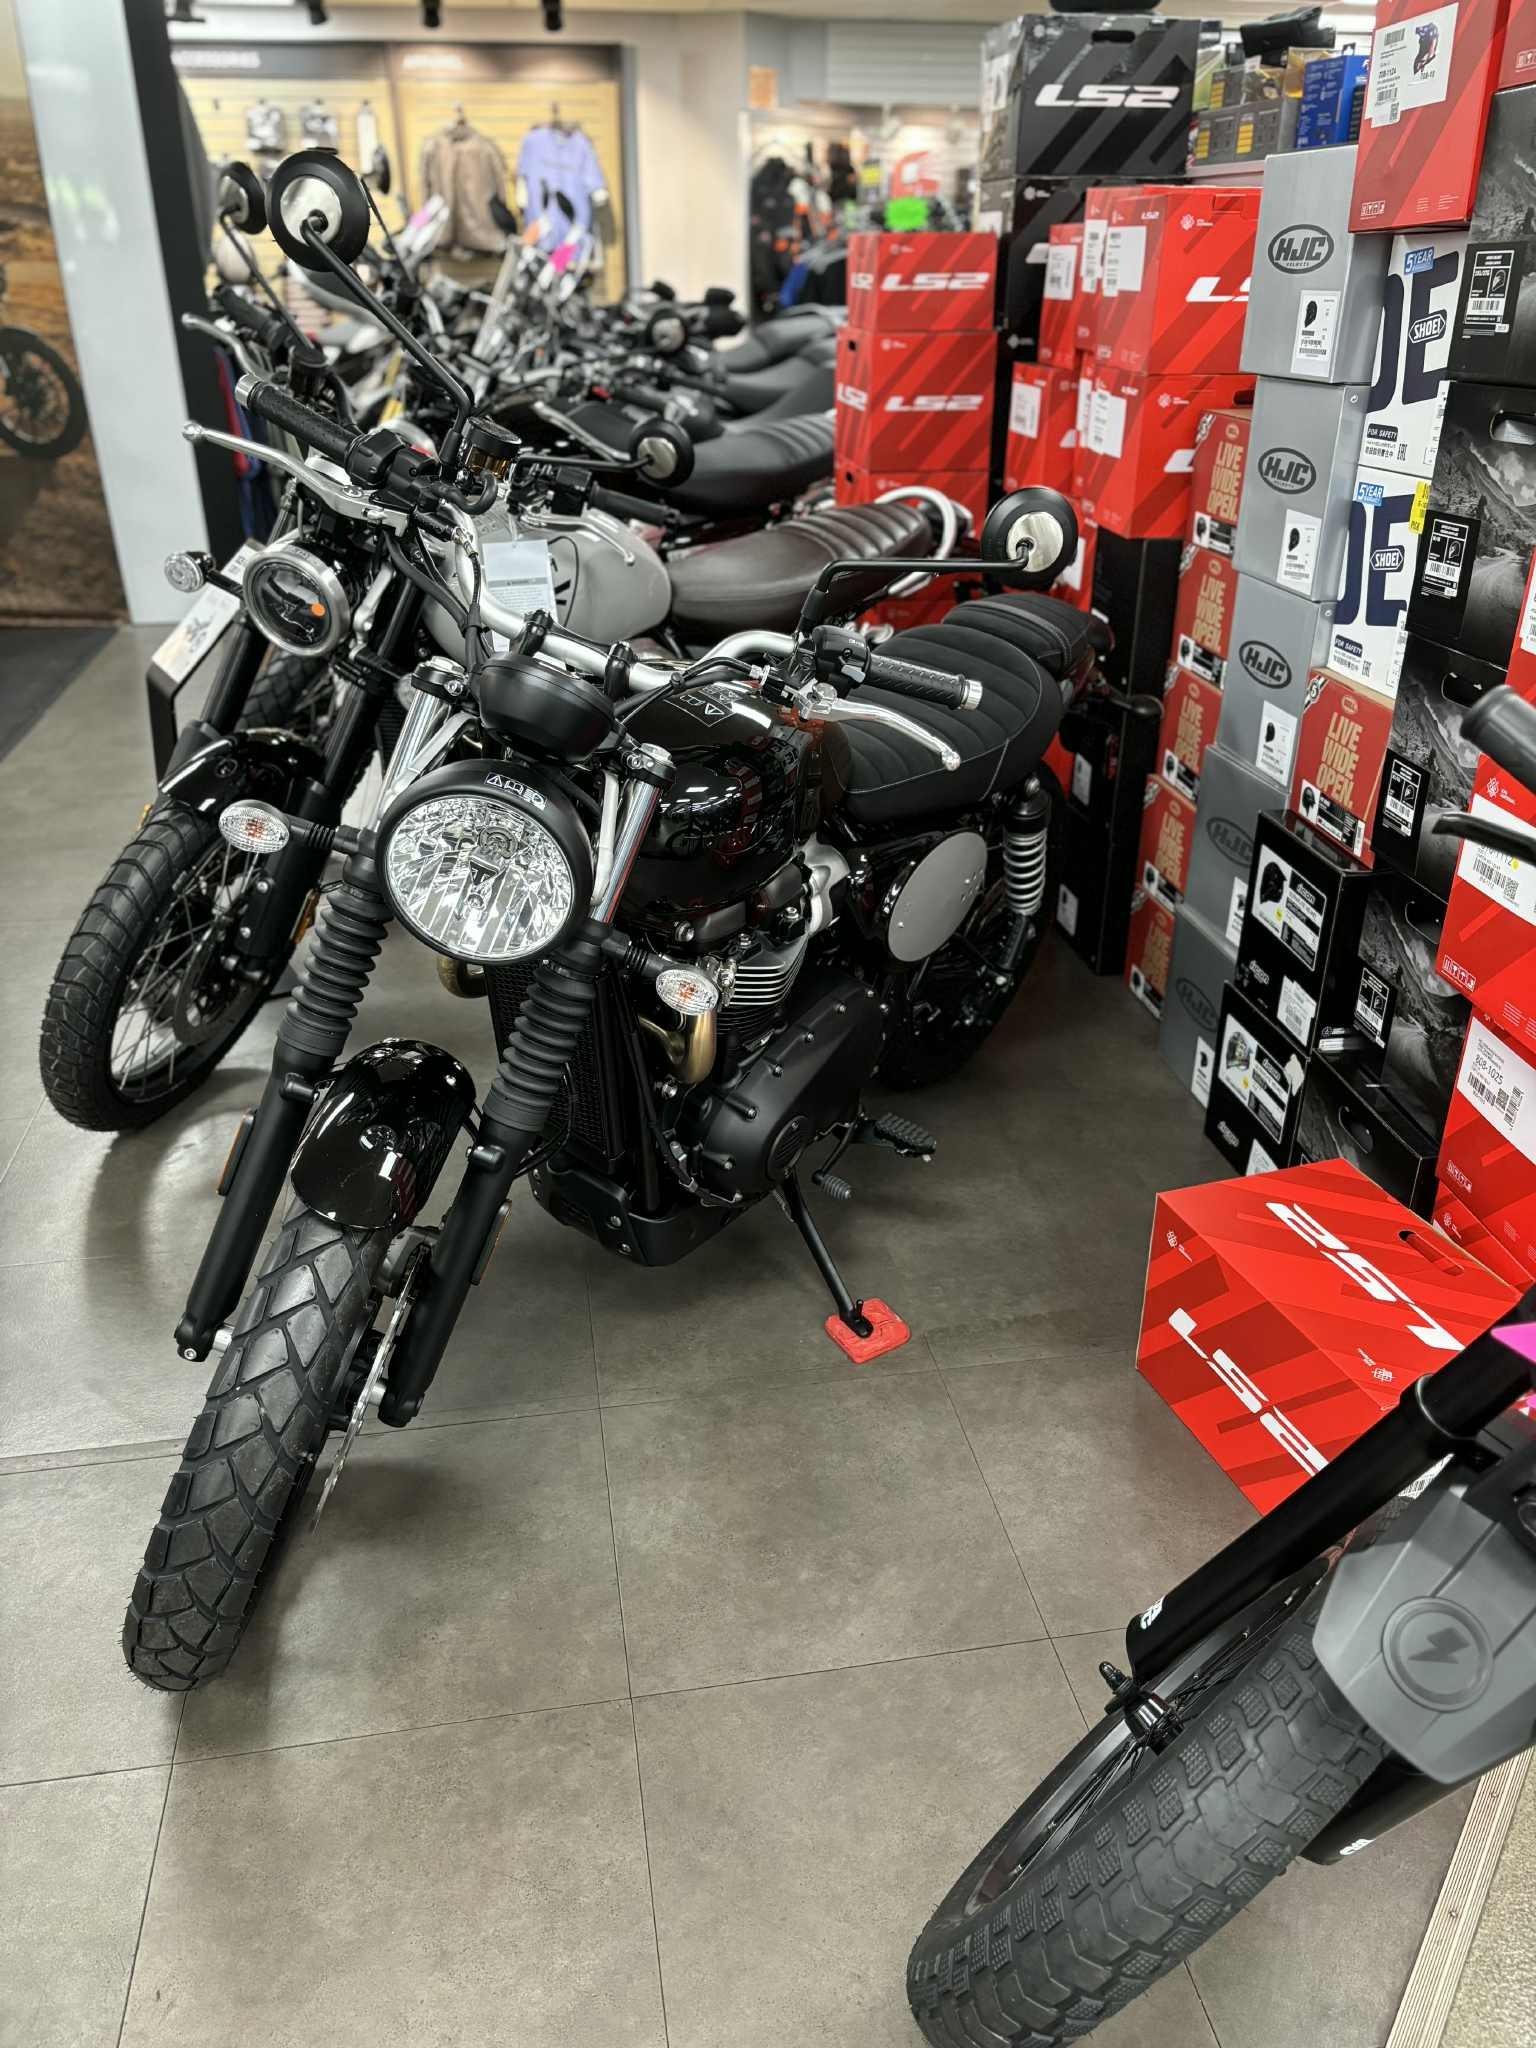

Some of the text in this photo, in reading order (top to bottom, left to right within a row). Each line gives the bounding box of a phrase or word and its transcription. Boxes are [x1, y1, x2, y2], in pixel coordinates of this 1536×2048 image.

[1035, 84, 1180, 108] LS2
[1274, 236, 1326, 262] HJC
[1414, 247, 1434, 264] YEAR
[880, 271, 990, 292] LS2
[1413, 317, 1441, 340] SHOEI
[884, 394, 984, 413] LS2
[1379, 430, 1397, 440] SAFETY
[1215, 440, 1244, 471] LIVE
[1264, 456, 1310, 486] HJC
[1365, 485, 1383, 499] YEAR
[1374, 552, 1400, 568] SHOEI
[1201, 573, 1226, 604] LIVE
[1344, 642, 1362, 655] SAFETY
[1244, 647, 1286, 682] HJC
[1327, 711, 1363, 752] LIVE
[1321, 736, 1360, 780] WIDE
[1265, 1202, 1467, 1351] LS2
[1168, 1307, 1330, 1476] LS2
